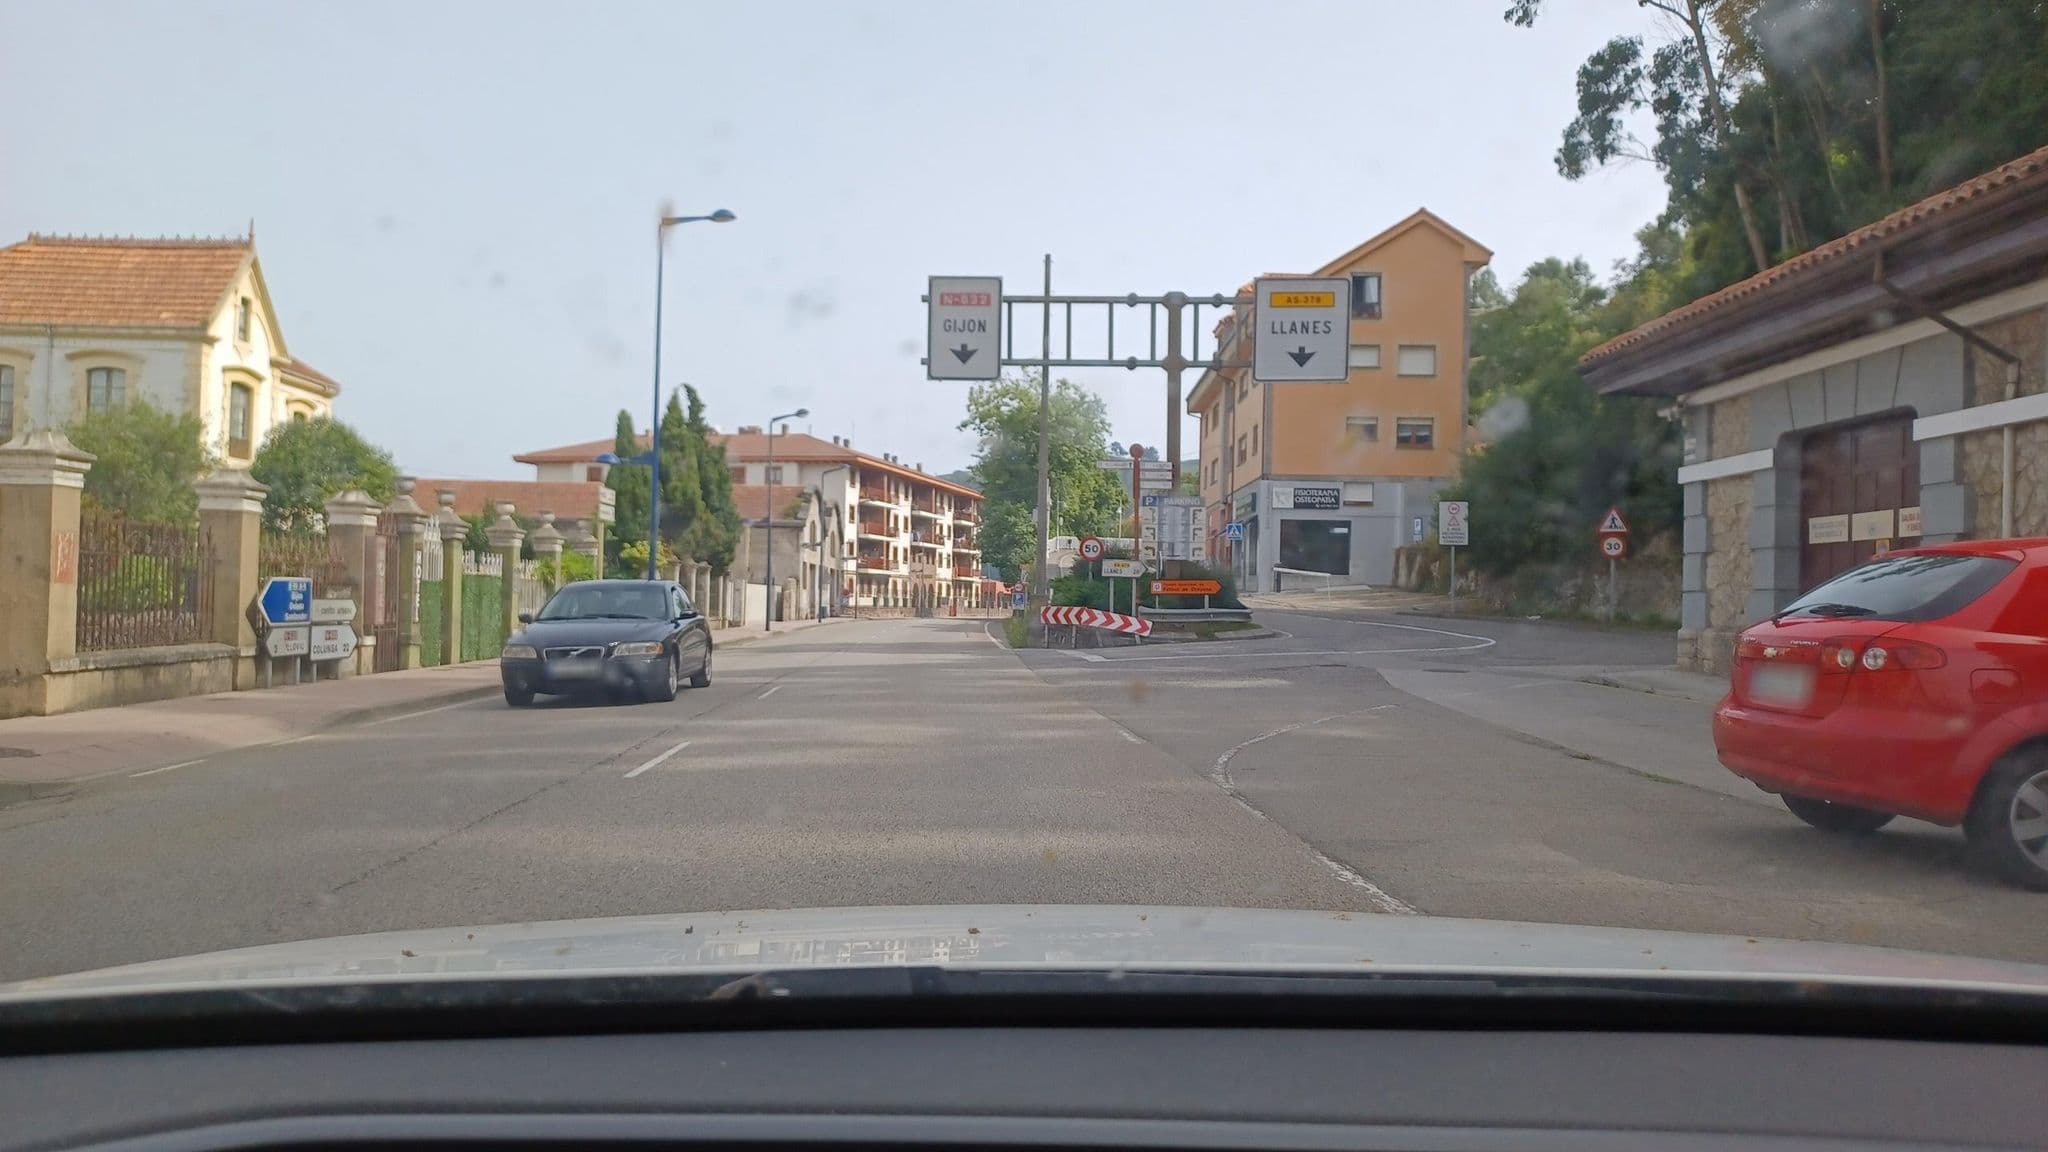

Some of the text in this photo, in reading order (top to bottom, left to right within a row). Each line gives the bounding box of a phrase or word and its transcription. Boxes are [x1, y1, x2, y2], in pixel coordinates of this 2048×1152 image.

[943, 318, 987, 333] GIJON
[1271, 320, 1332, 334] LLANES
[1084, 544, 1099, 553] 50
[1606, 542, 1621, 551] 30
